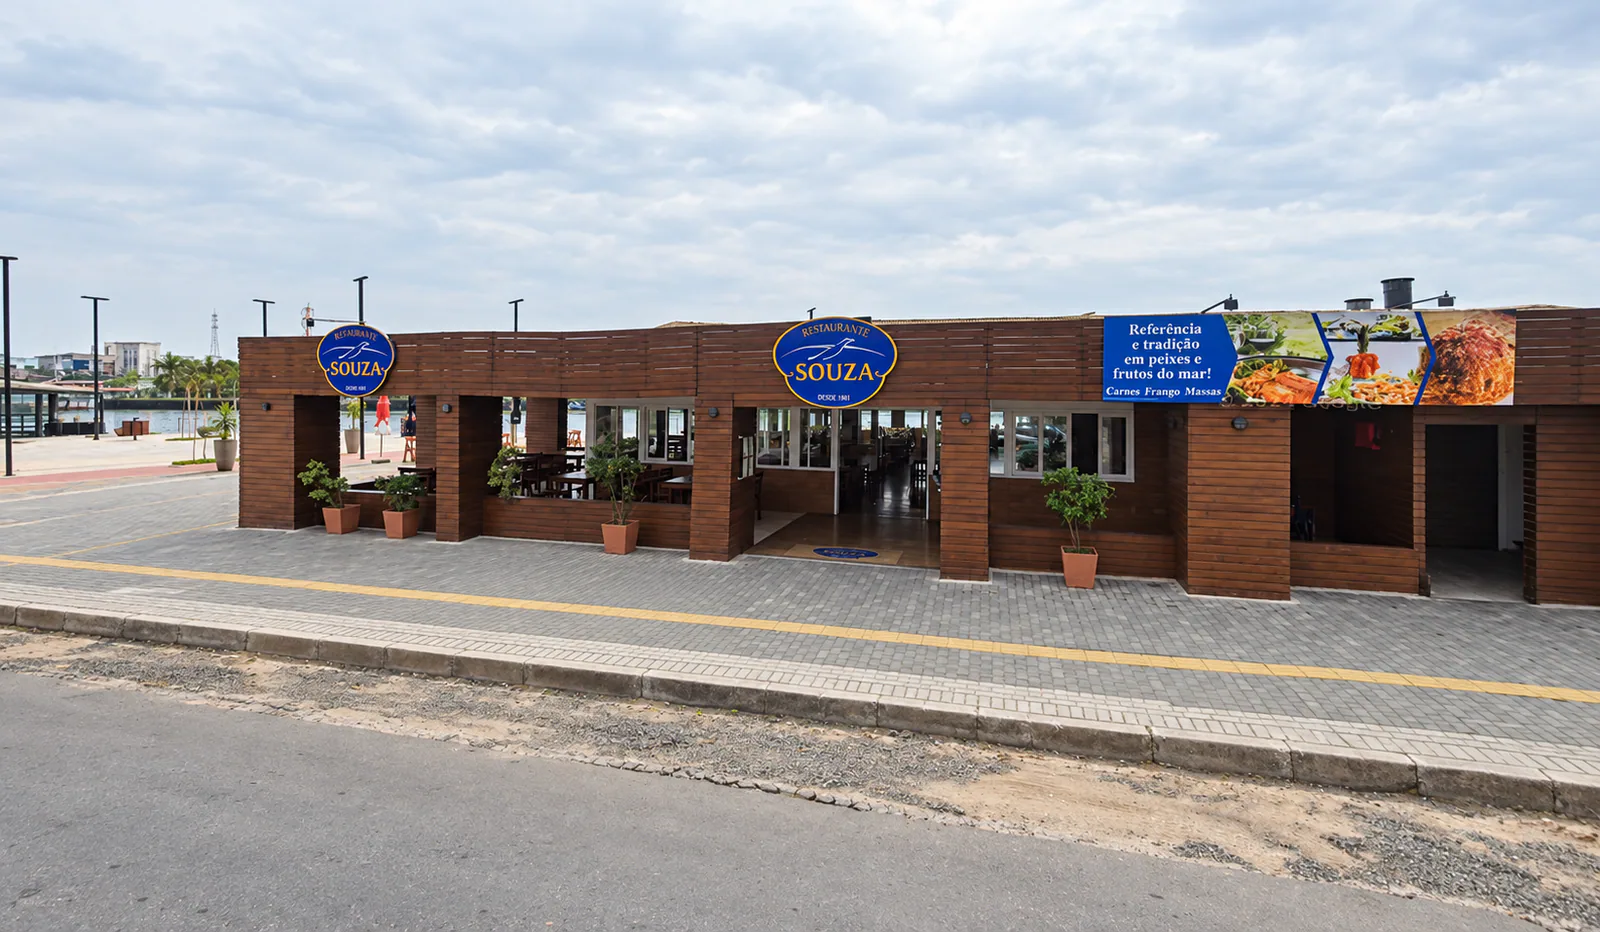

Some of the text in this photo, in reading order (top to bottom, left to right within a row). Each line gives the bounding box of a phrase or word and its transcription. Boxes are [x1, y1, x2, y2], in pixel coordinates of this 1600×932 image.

[801, 322, 871, 338] RESTAURANTE
[1129, 322, 1202, 336] Referência
[1132, 338, 1200, 352] e tradição
[1124, 353, 1202, 367] em peixes e
[330, 360, 382, 376] SOUZA
[795, 362, 875, 381] SOUZA
[1113, 367, 1212, 380] frutos do mar!
[1106, 386, 1222, 398] Carnes Frango Massas
